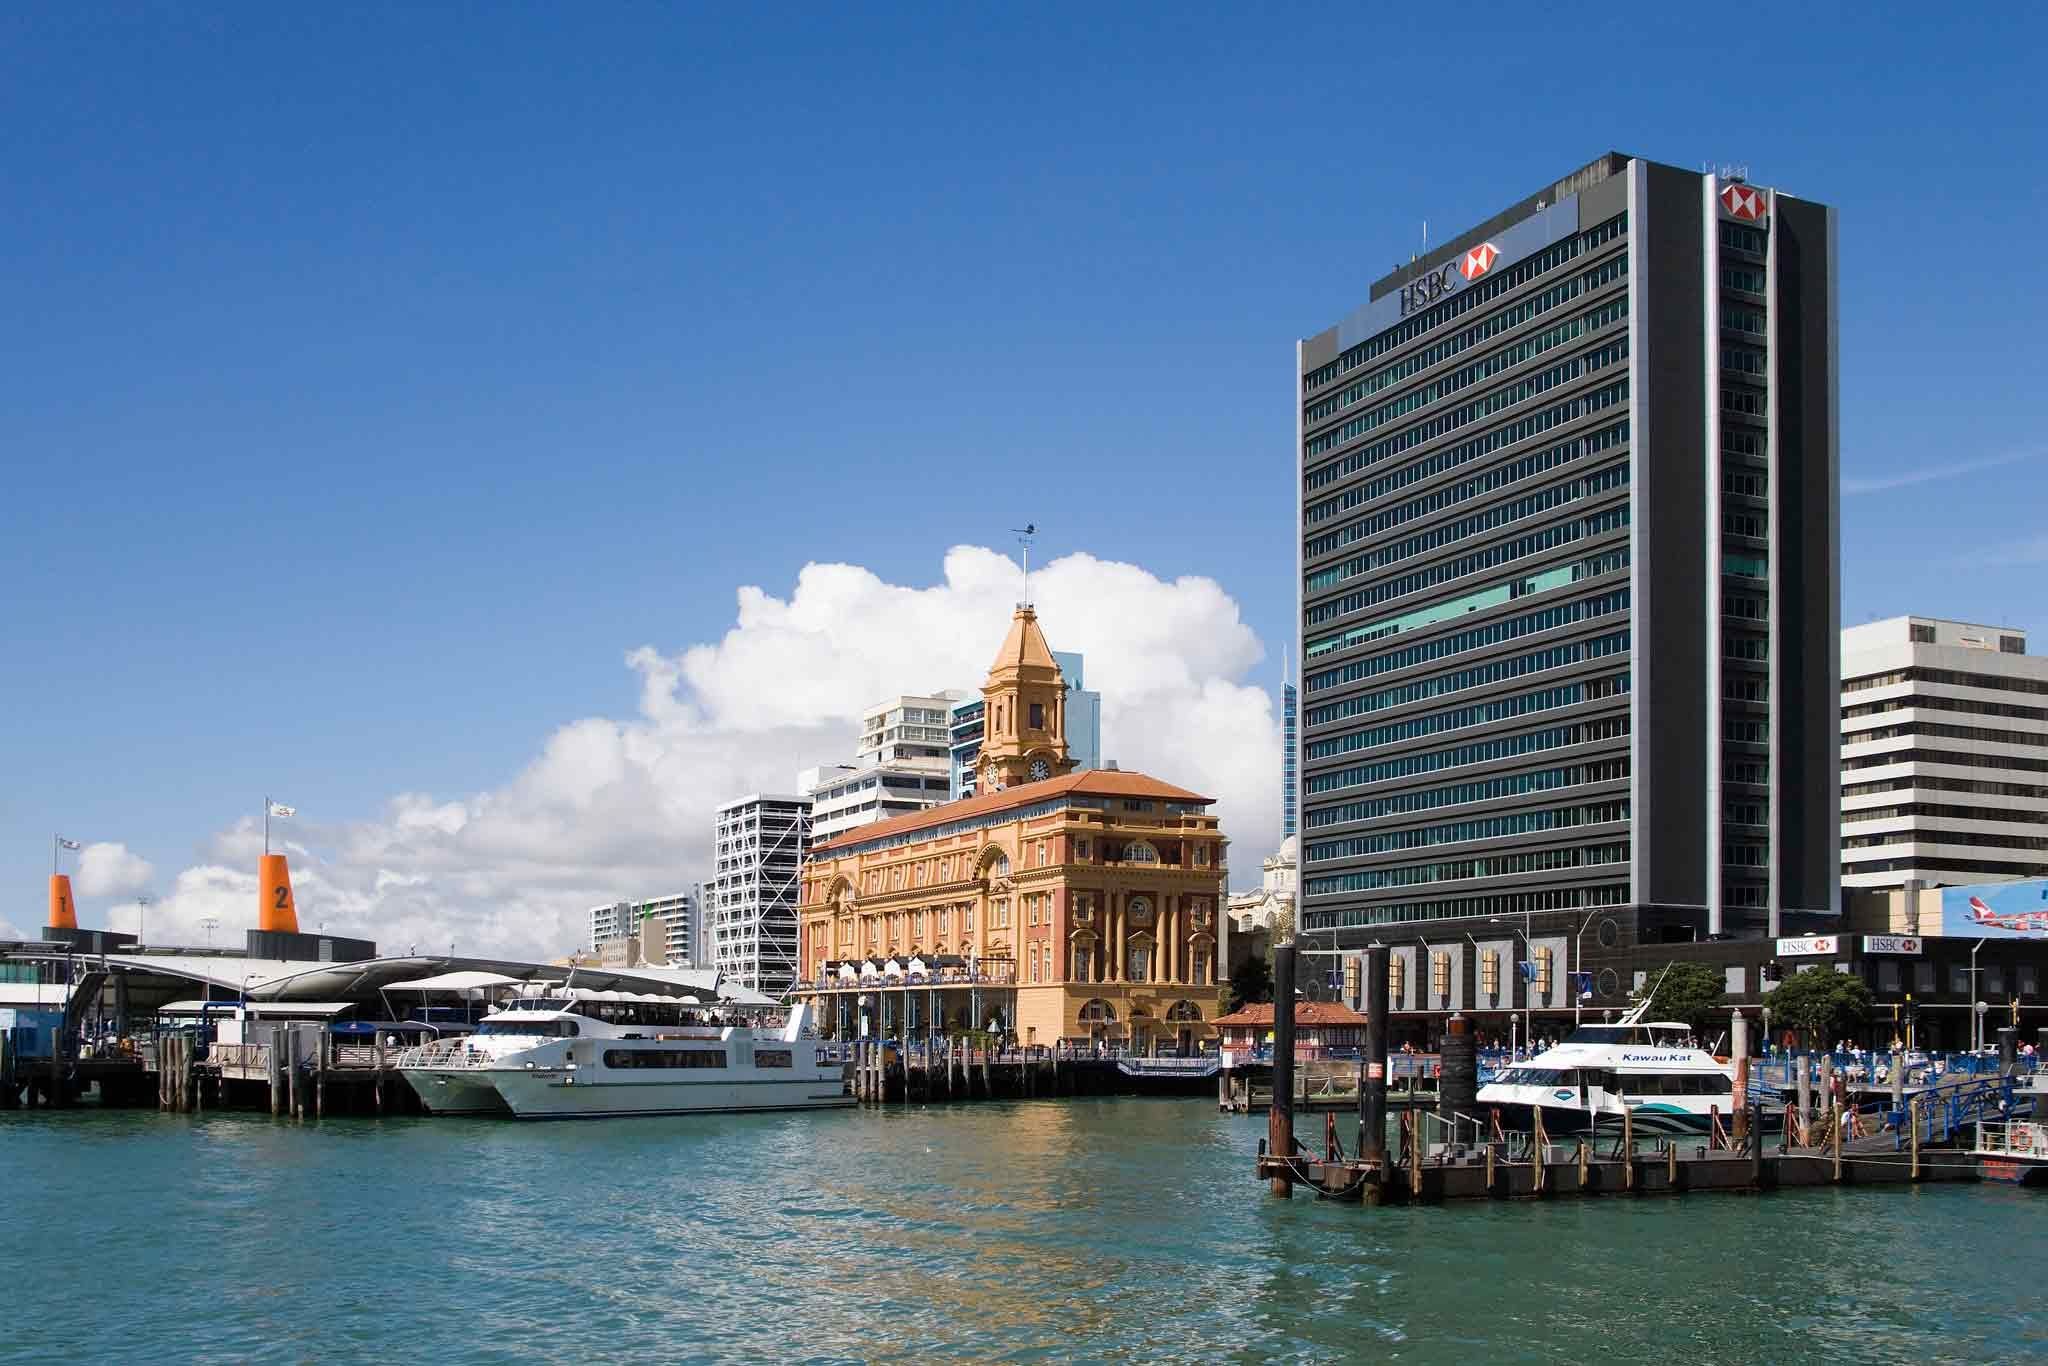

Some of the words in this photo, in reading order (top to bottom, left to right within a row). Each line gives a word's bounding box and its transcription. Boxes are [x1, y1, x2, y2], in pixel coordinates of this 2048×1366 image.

[1400, 262, 1457, 316] HSBC
[60, 896, 67, 912] 1
[275, 887, 288, 908] 2
[1783, 940, 1809, 952] HSBC
[1872, 938, 1899, 951] HSBC
[1622, 1054, 1667, 1062] Kawau
[1669, 1054, 1692, 1062] Kat
